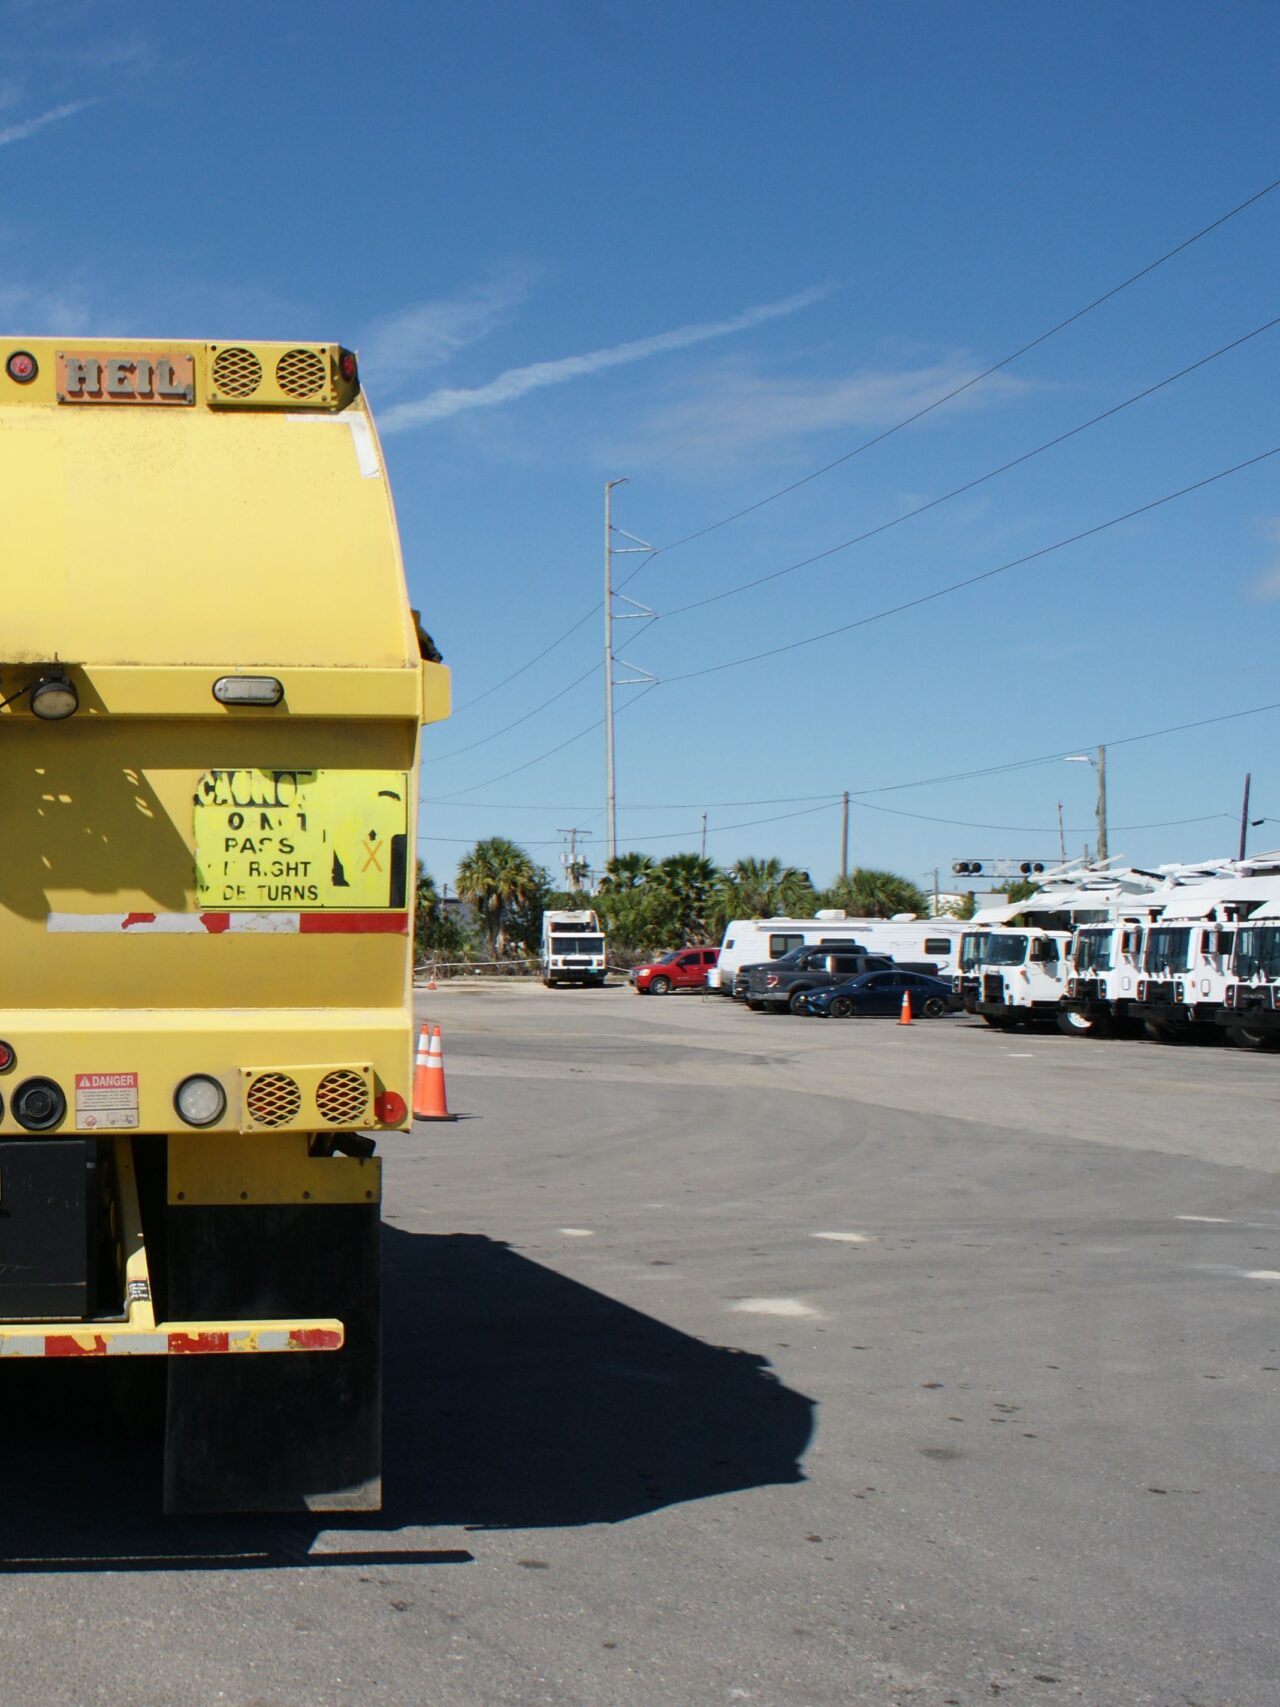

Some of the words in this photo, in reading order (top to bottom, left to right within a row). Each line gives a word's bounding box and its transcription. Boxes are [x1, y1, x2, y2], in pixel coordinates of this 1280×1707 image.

[66, 358, 192, 398] HEIL
[249, 860, 312, 877] RGHT
[257, 884, 319, 901] TURNS
[92, 1075, 134, 1087] DANGER
